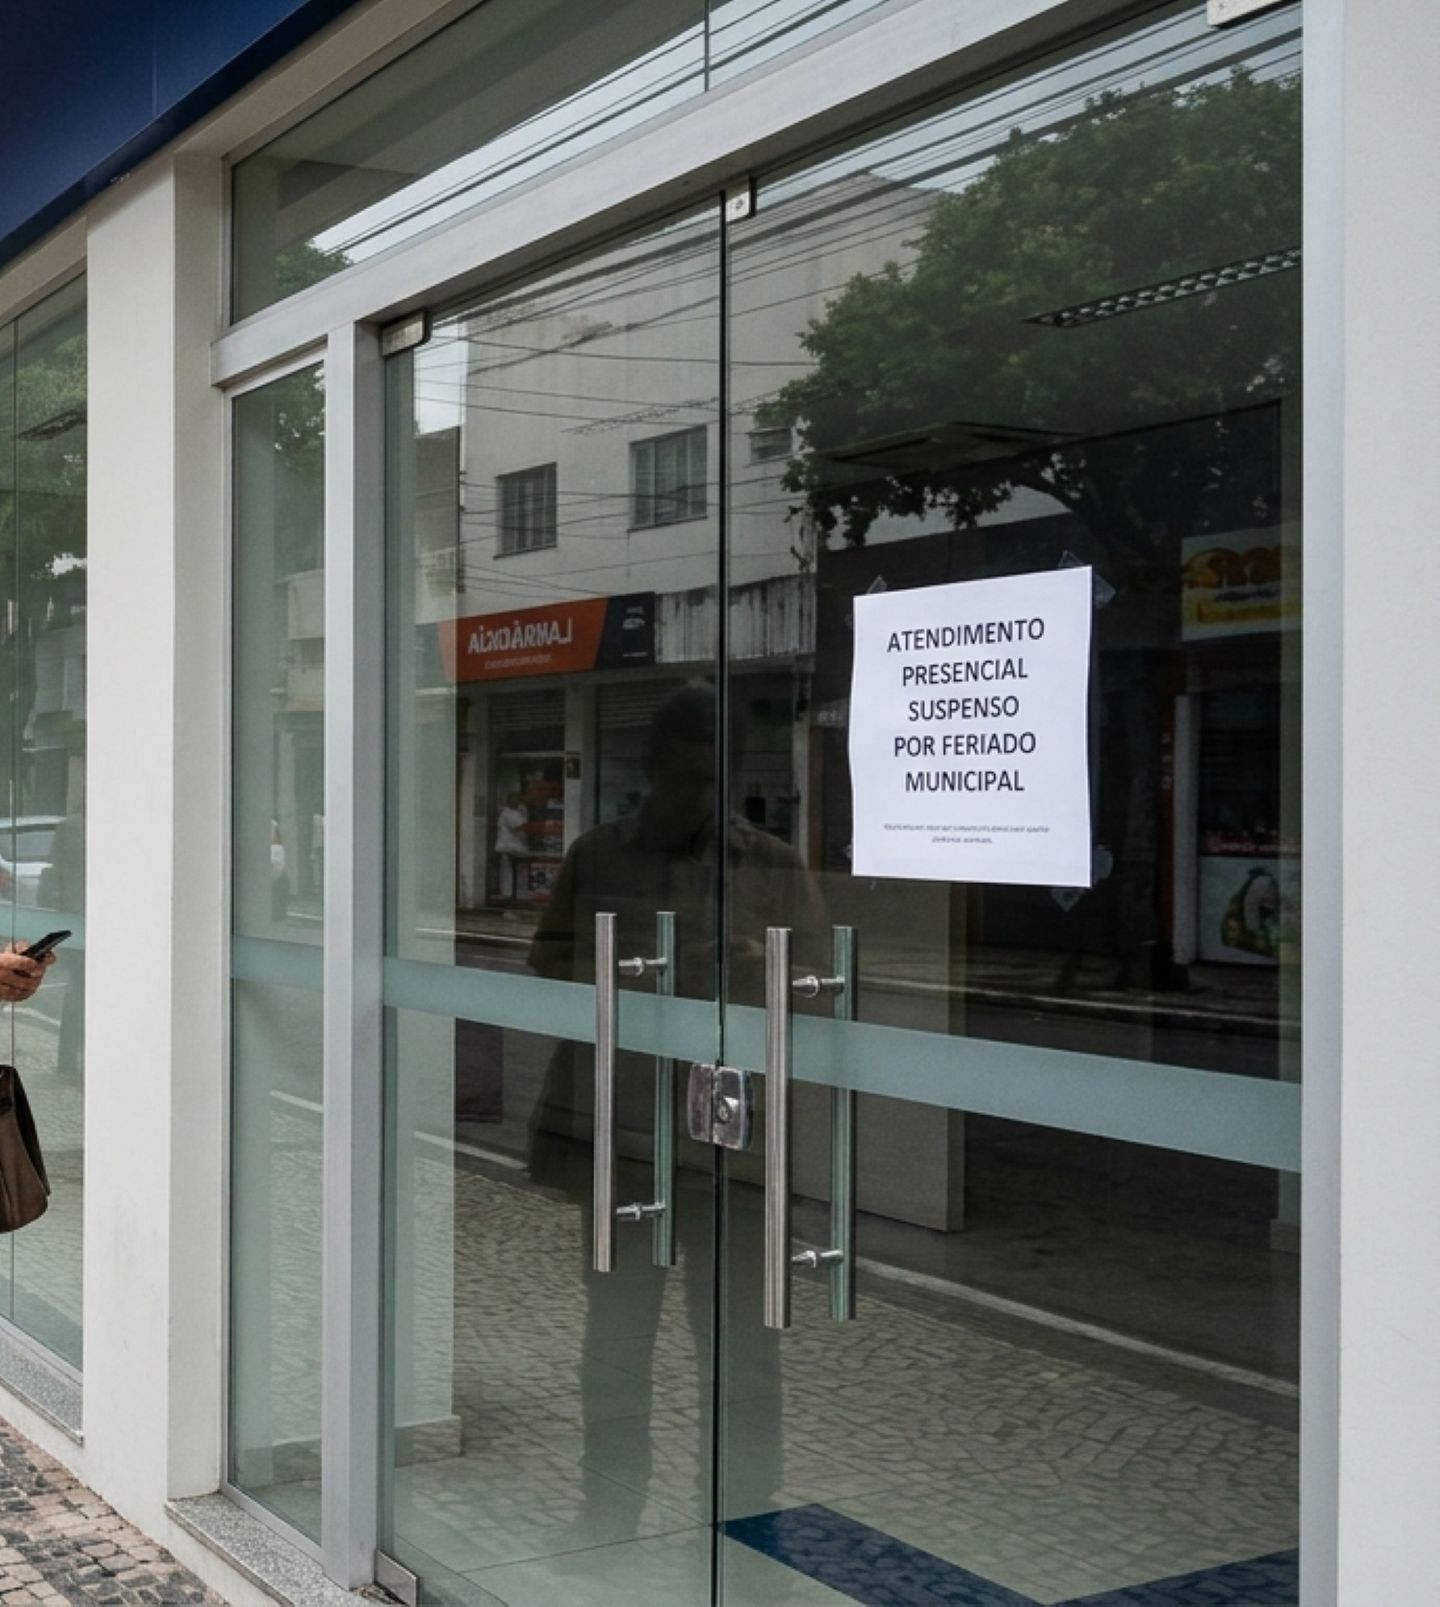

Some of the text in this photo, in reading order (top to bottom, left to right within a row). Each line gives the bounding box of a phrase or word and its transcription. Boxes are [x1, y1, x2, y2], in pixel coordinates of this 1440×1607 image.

[887, 617, 1046, 653] ATENDIMENTO
[902, 657, 1029, 687] PRESENCIAL
[908, 695, 1020, 722] SUSPENSO
[894, 731, 1037, 757] POR FERIADO
[905, 769, 1026, 793] MUNICIPAL
